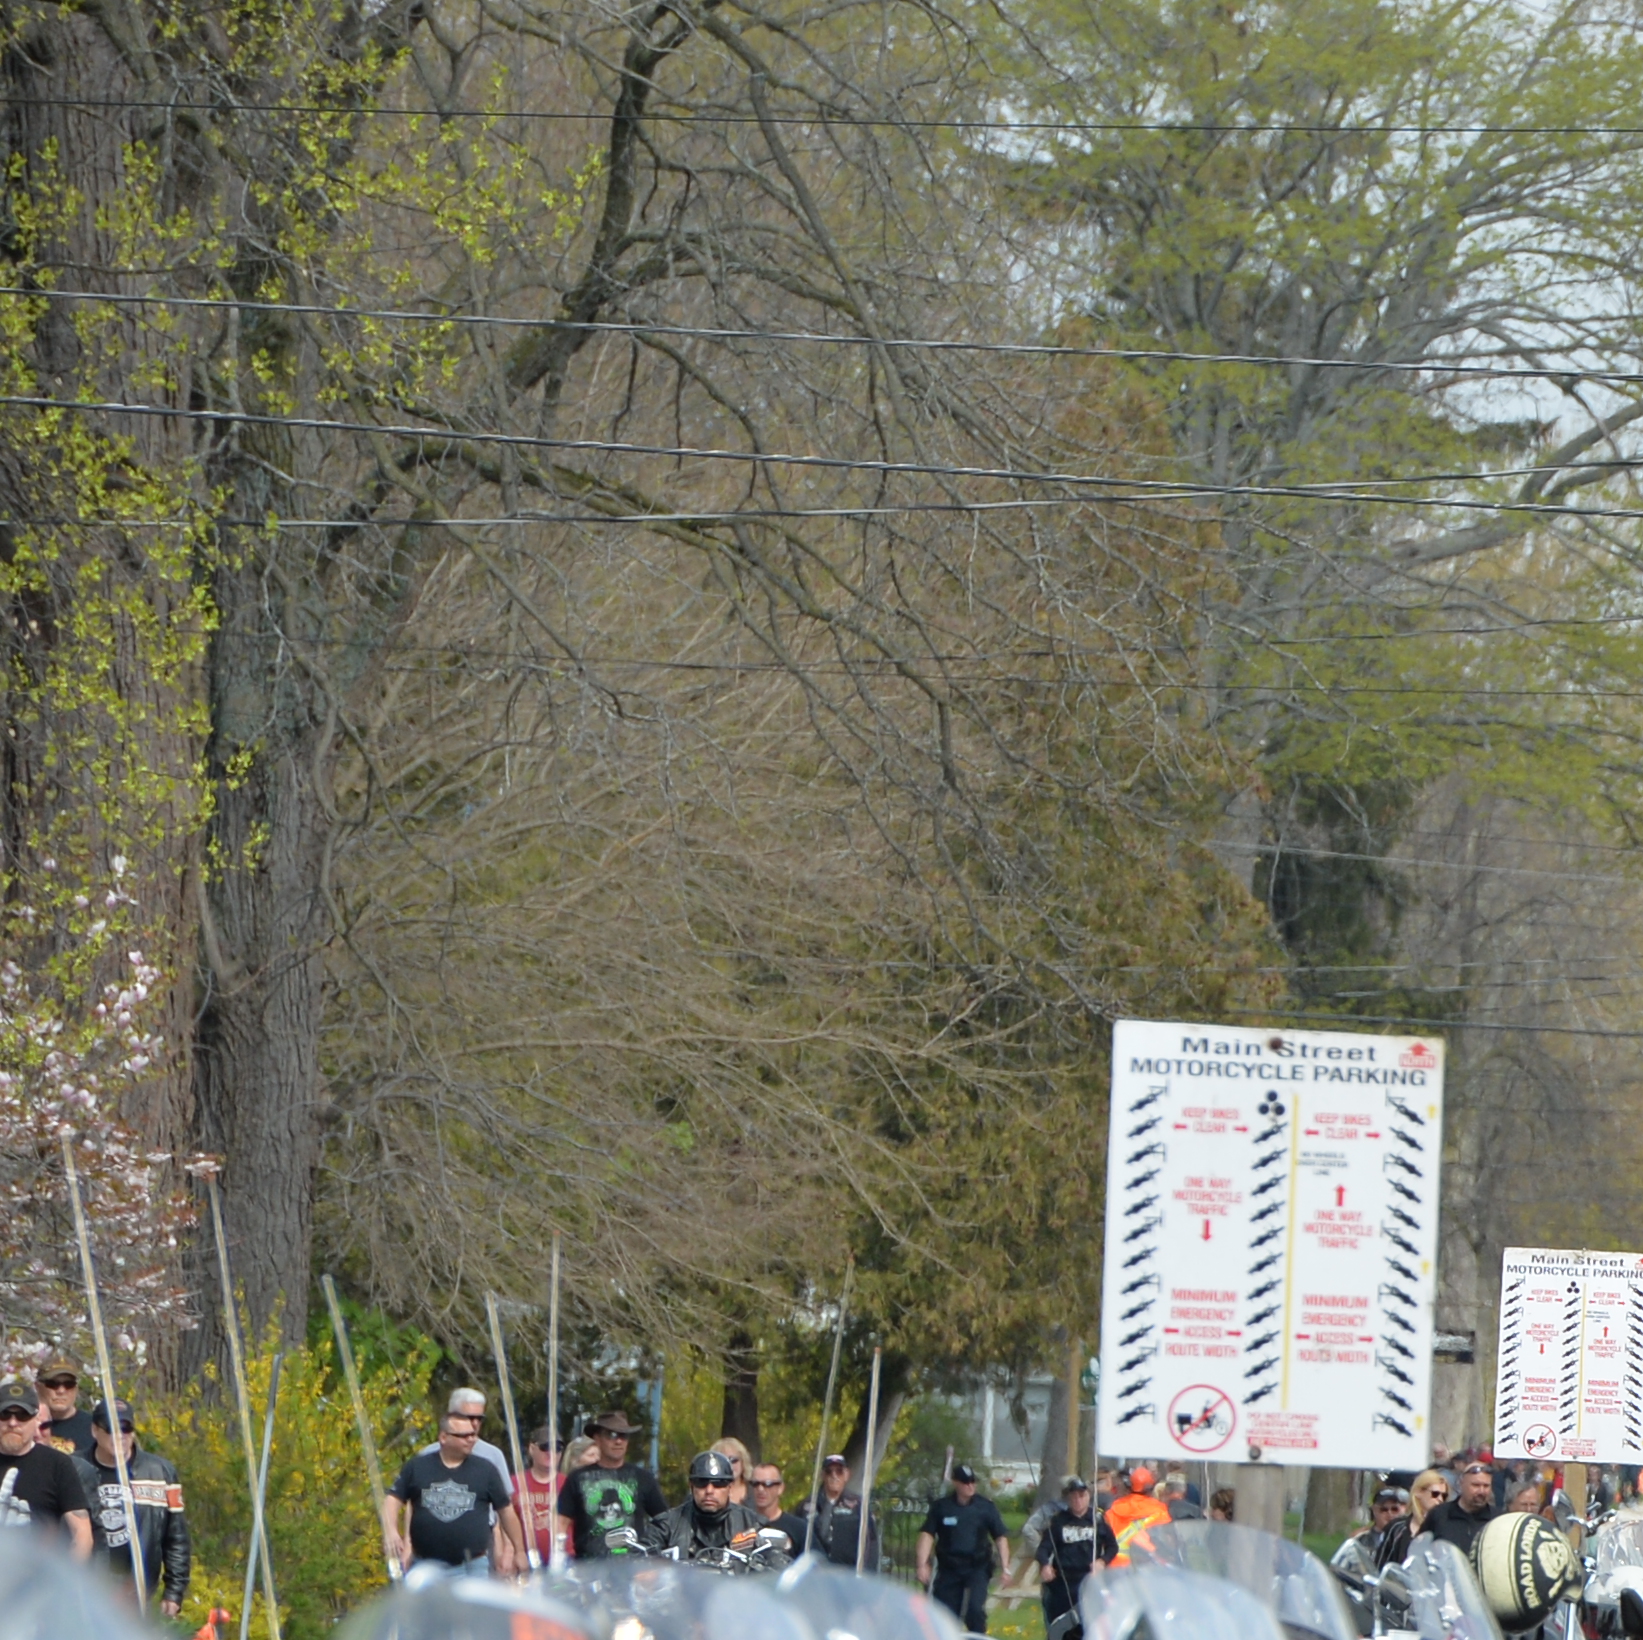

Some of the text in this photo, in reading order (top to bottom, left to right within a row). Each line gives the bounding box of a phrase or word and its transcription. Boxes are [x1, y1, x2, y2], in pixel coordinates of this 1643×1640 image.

[1181, 1037, 1376, 1062] Main Street
[1130, 1056, 1427, 1086] MOTORCYCLE PARKING
[1506, 1264, 1589, 1277] MOTORCYCLE
[1531, 1254, 1569, 1265] Main
[1573, 1255, 1625, 1267] Street
[1520, 1518, 1542, 1609] ROAD LORDS
